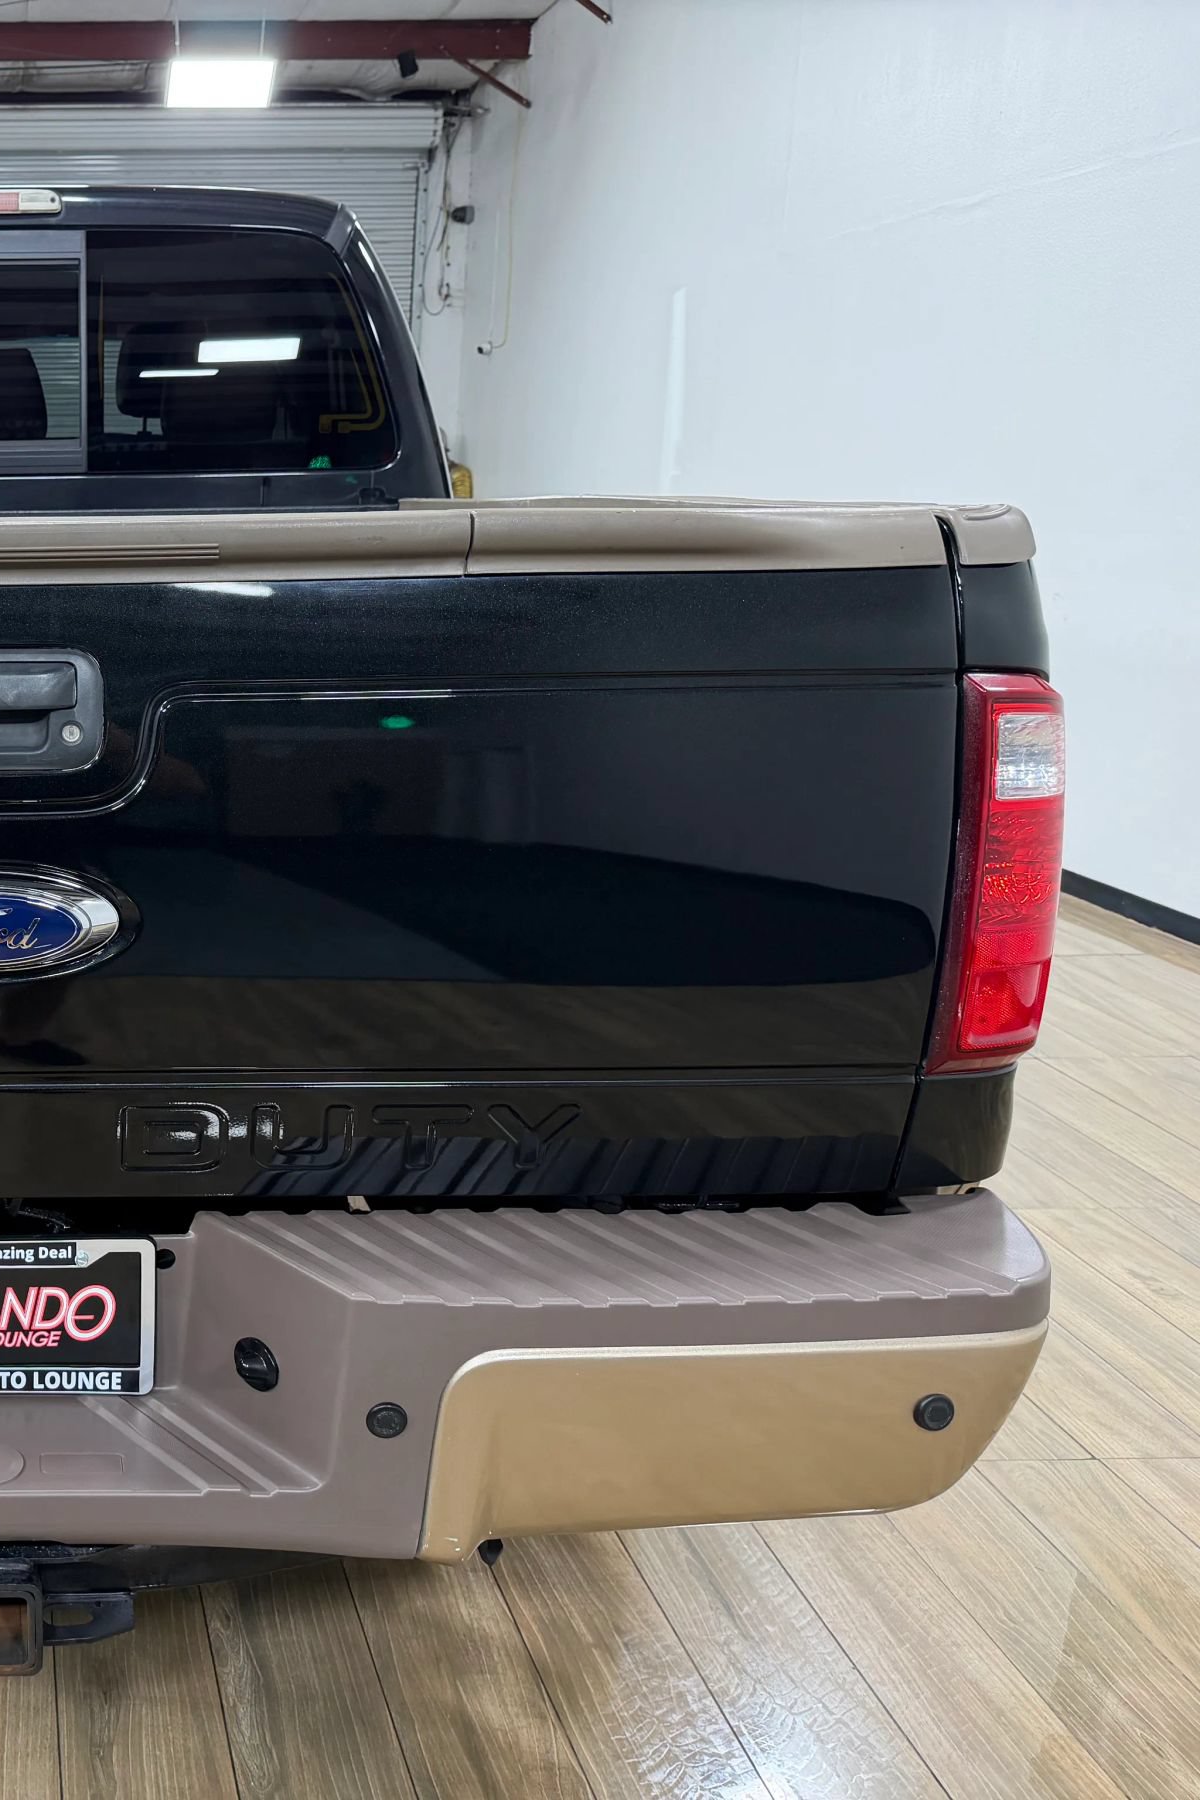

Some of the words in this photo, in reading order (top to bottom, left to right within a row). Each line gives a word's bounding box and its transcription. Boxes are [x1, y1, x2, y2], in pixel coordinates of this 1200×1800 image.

[116, 1101, 583, 1172] DUTY
[38, 1245, 73, 1260] Deal
[33, 1371, 122, 1391] LOUNGE
